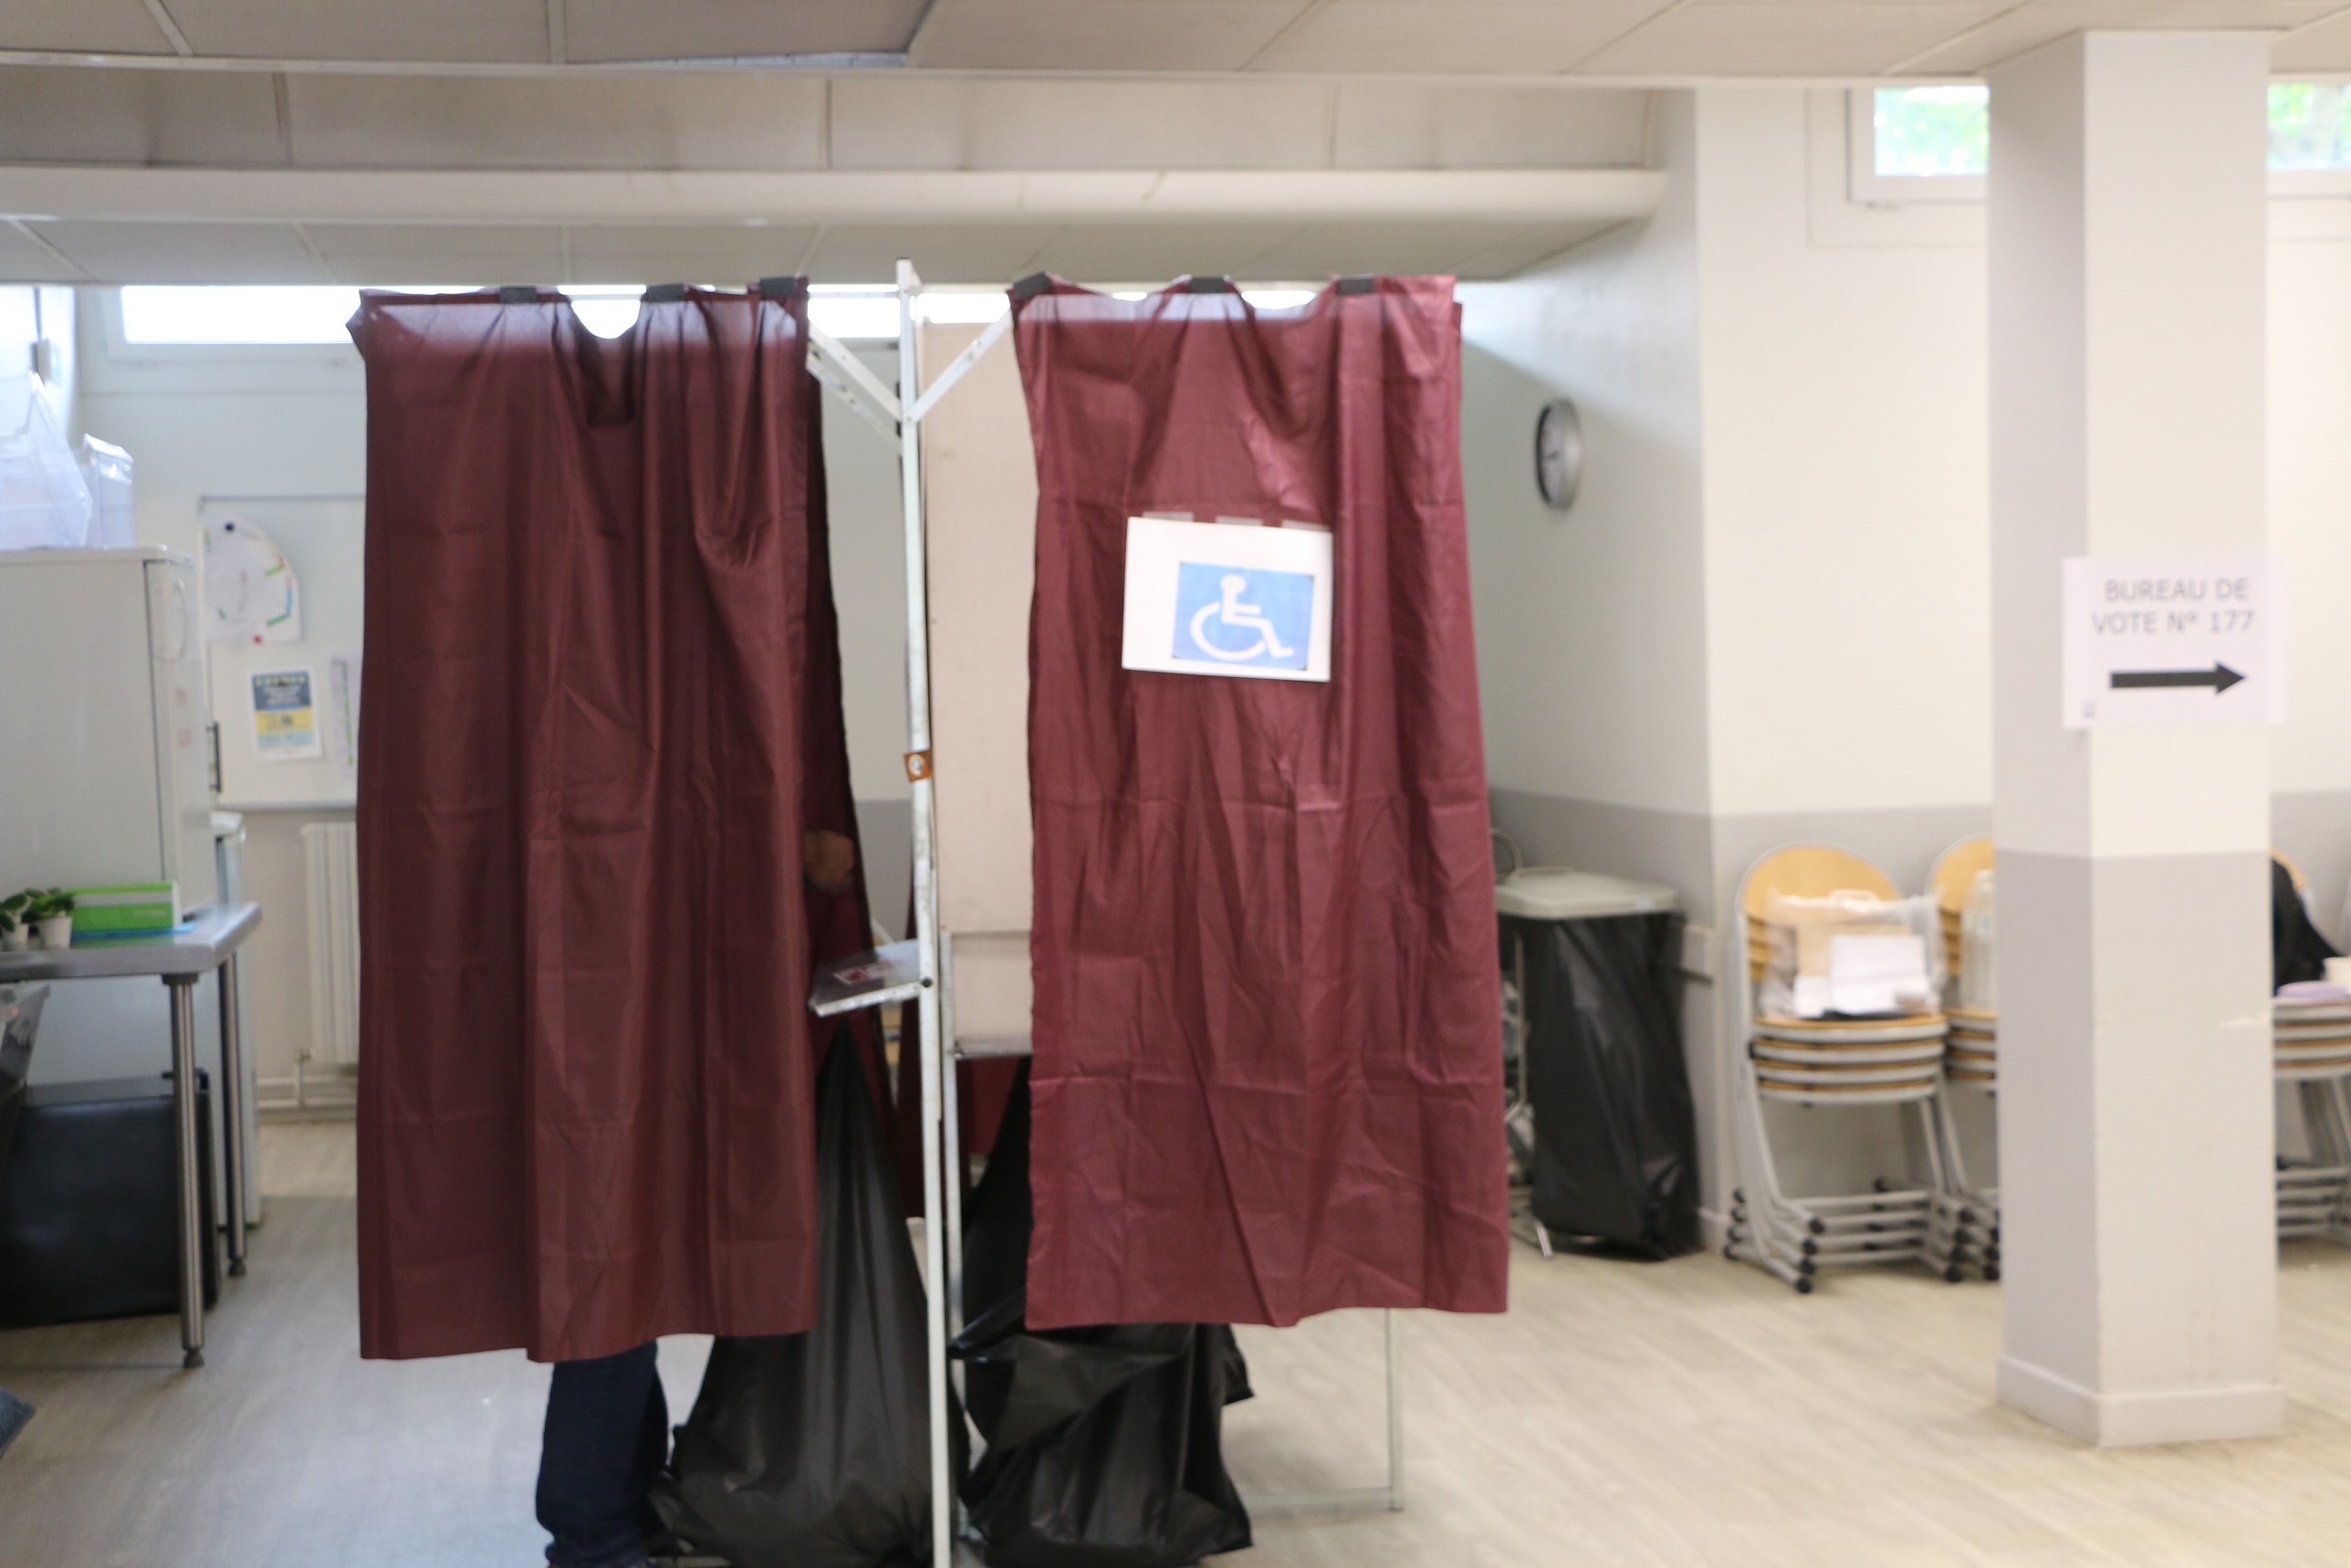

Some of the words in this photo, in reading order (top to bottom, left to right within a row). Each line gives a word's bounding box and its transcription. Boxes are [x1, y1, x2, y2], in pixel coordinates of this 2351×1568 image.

[2105, 579, 2207, 602] BUREAU
[2215, 578, 2249, 600] DE
[2091, 611, 2158, 634] VOTE
[2209, 609, 2254, 632] 177
